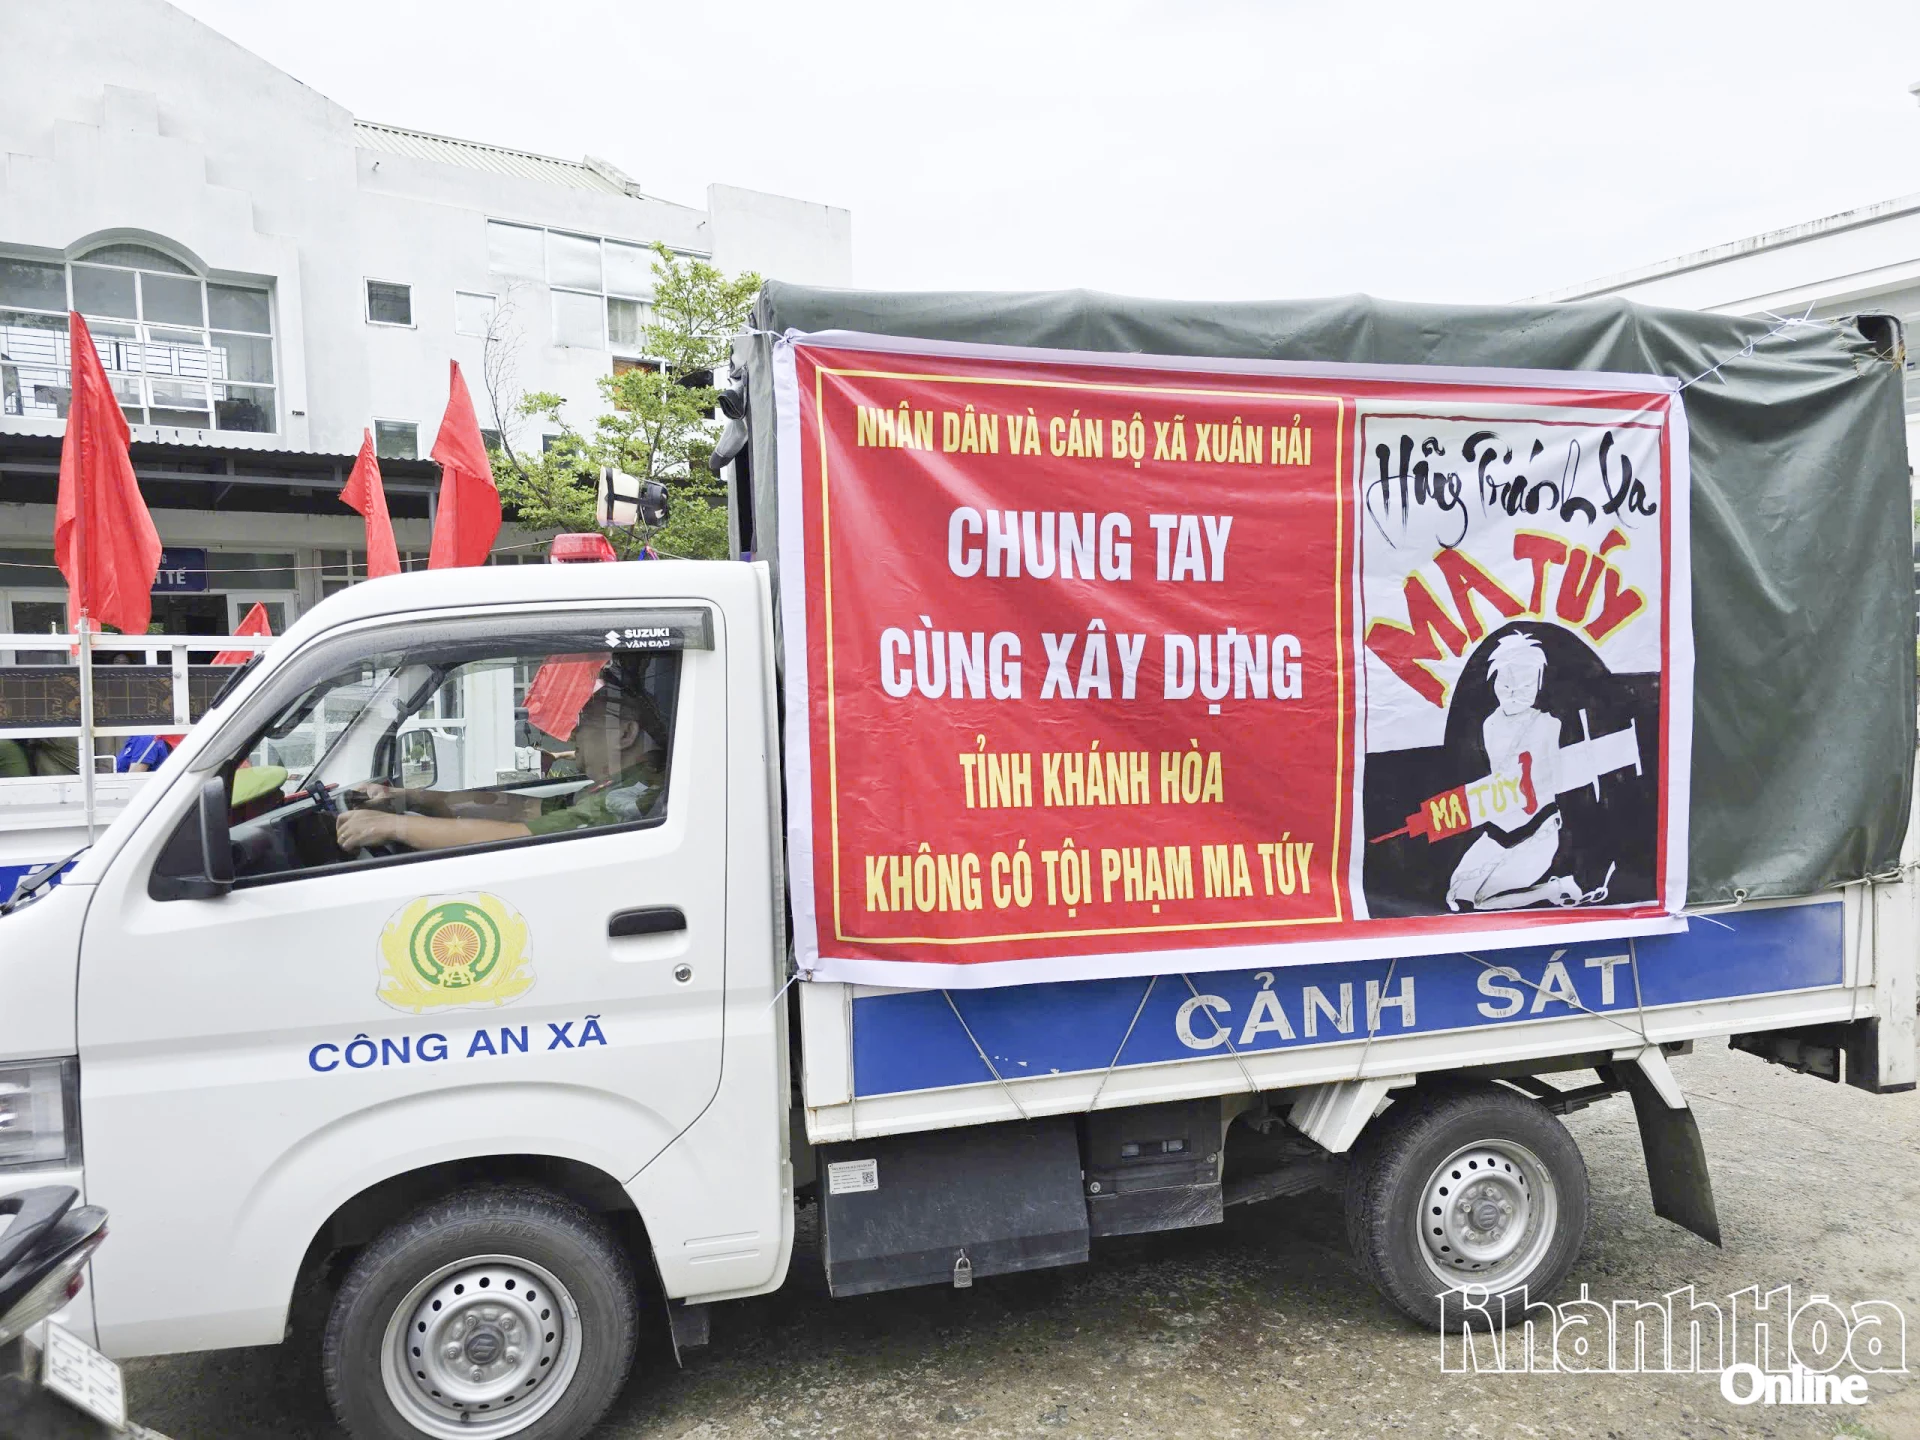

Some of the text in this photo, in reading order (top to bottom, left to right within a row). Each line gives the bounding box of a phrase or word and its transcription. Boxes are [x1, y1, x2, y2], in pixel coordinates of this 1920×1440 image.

[857, 401, 1312, 469] NHÂN DÂN VÀ CÁN BỘ XÃ XUÂN HẢI
[947, 506, 1234, 582] CHUNG TAY
[624, 627, 670, 638] SUZUKI
[880, 614, 1303, 715] CÙNG XÂY DỰNG
[1365, 548, 1528, 709] MA
[959, 733, 1224, 809] TỈNH KHÁNH HÒA
[1430, 772, 1519, 832] MA TÚY
[866, 830, 1315, 918] KHÔNG CÓ TỘI PHẠM MA TÚY
[1175, 948, 1630, 1050] CẢNH SÁT
[308, 1014, 608, 1073] CÔNG AN XÃ
